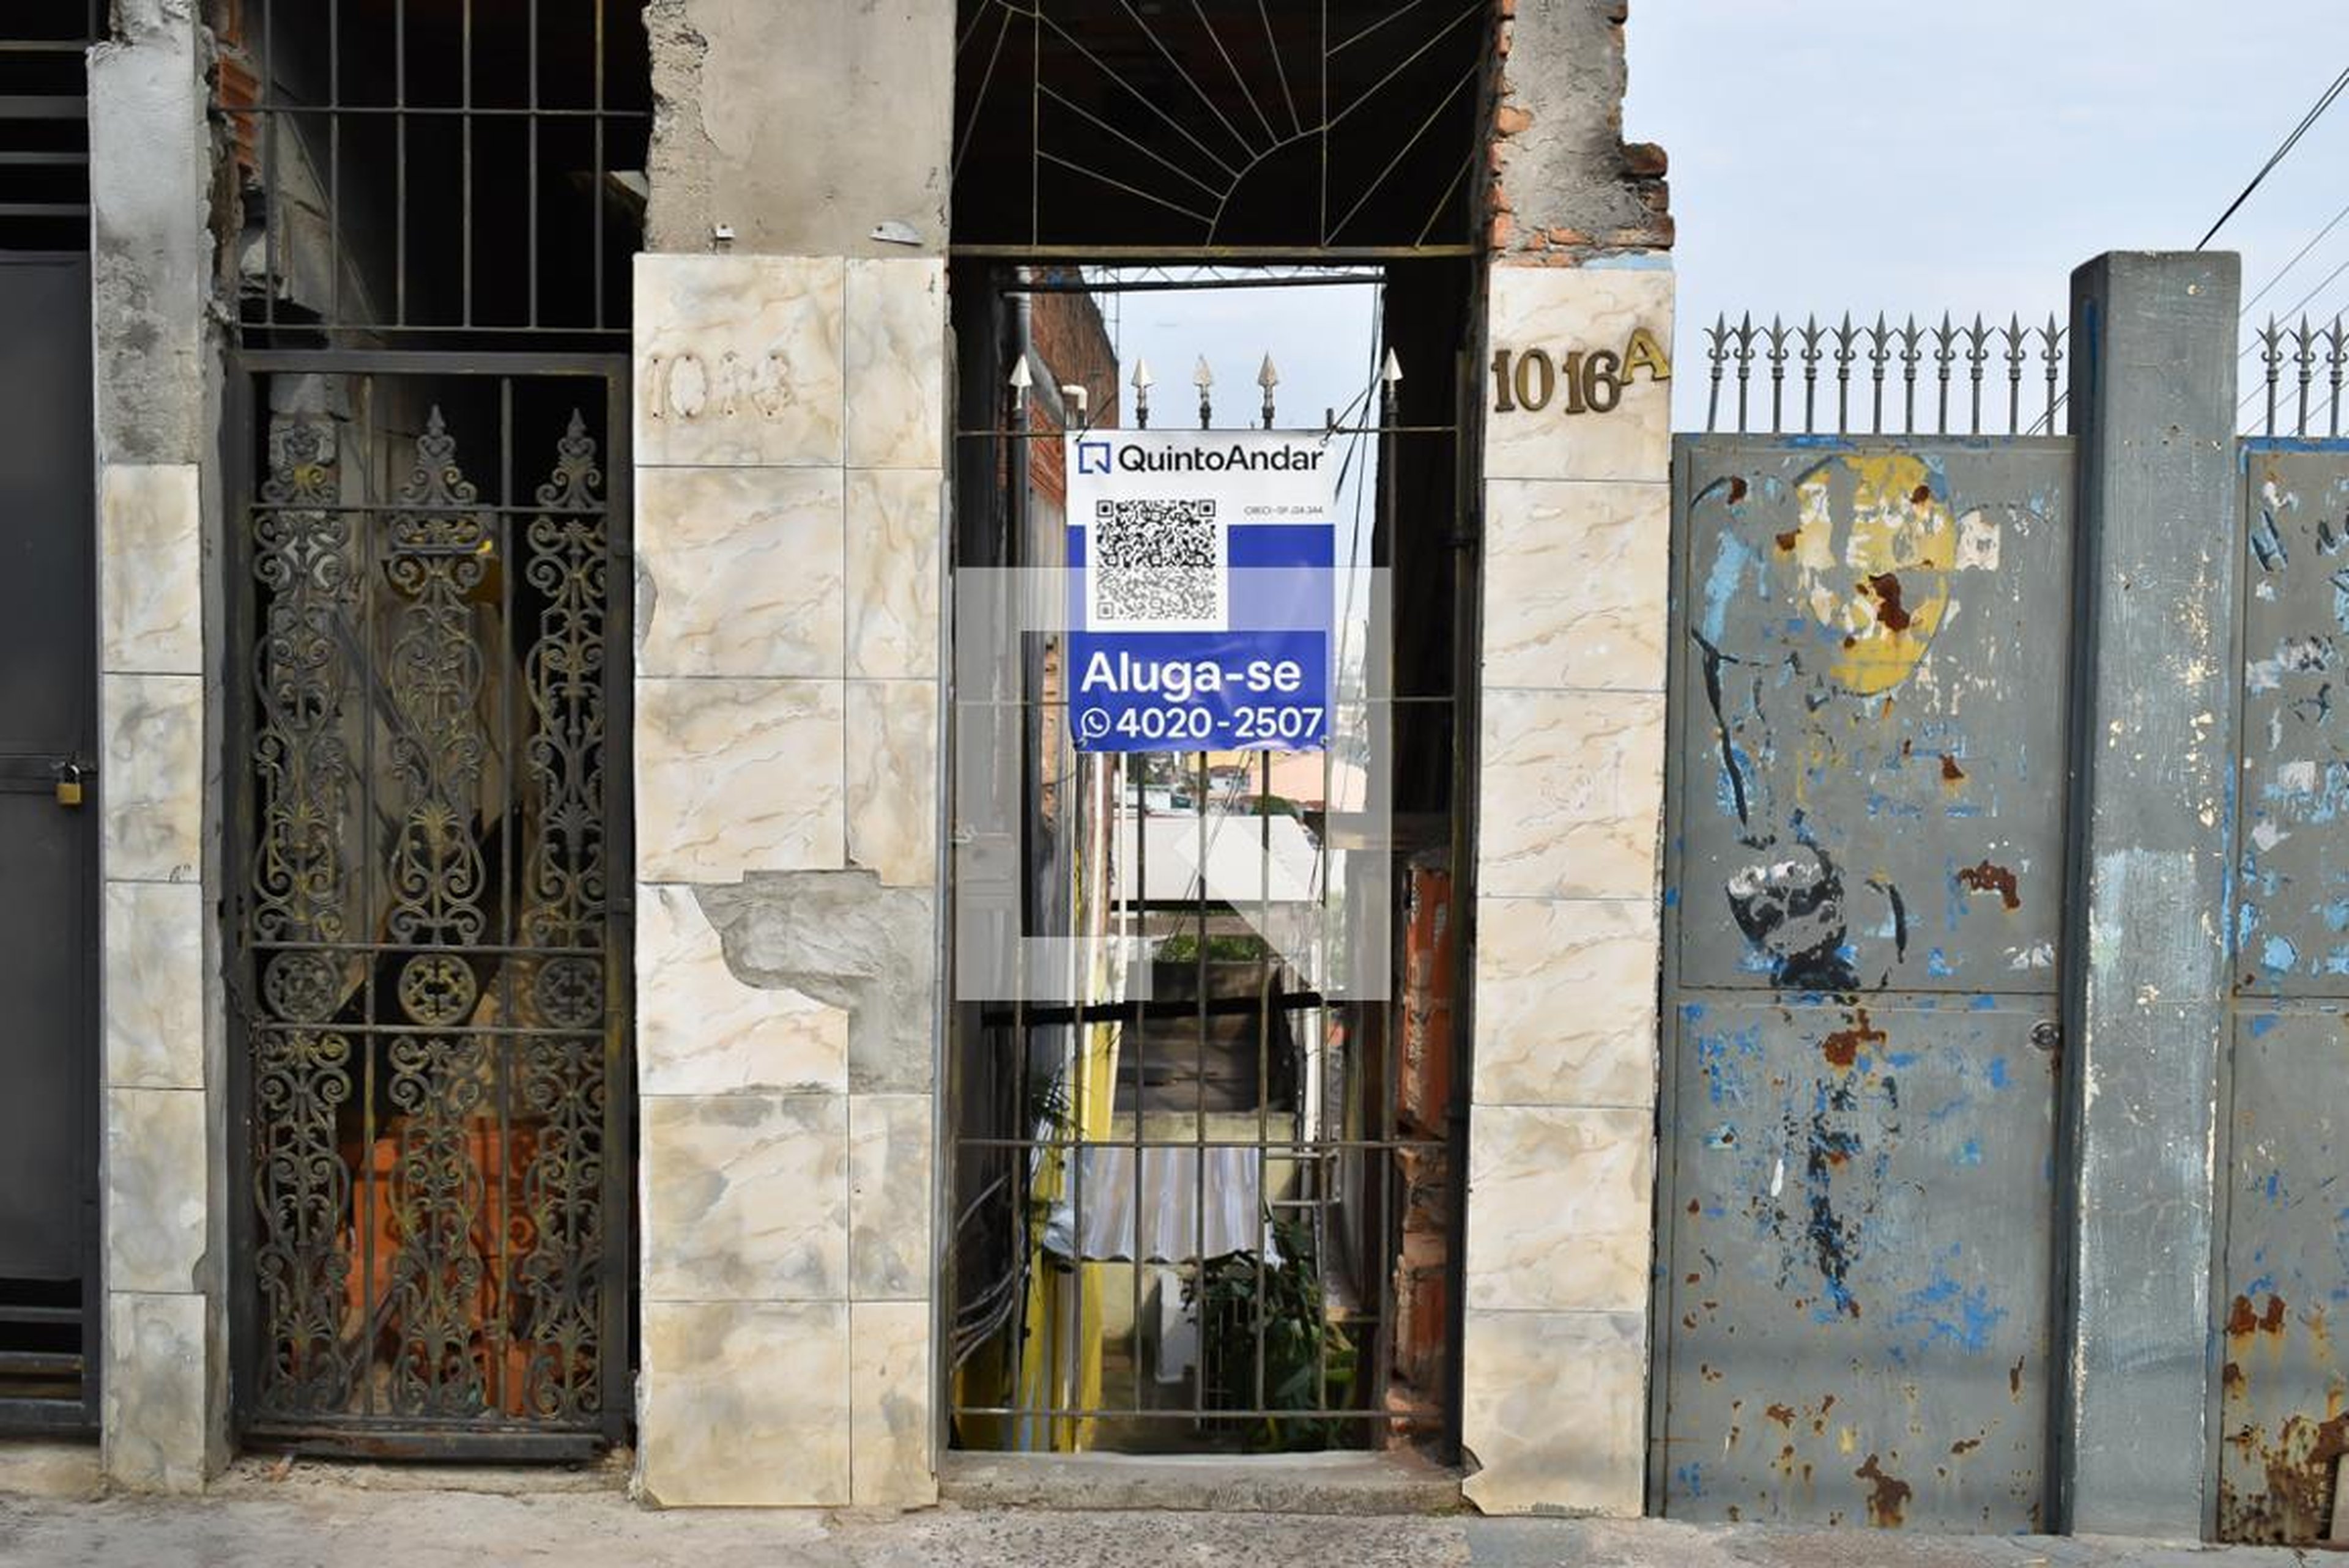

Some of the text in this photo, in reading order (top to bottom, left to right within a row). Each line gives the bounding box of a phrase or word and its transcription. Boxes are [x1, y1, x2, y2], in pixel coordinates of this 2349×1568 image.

[1118, 445, 1324, 472] QuintoAndar
[1081, 652, 1301, 701] Aluga-se
[1116, 707, 1324, 738] 4020-2507
